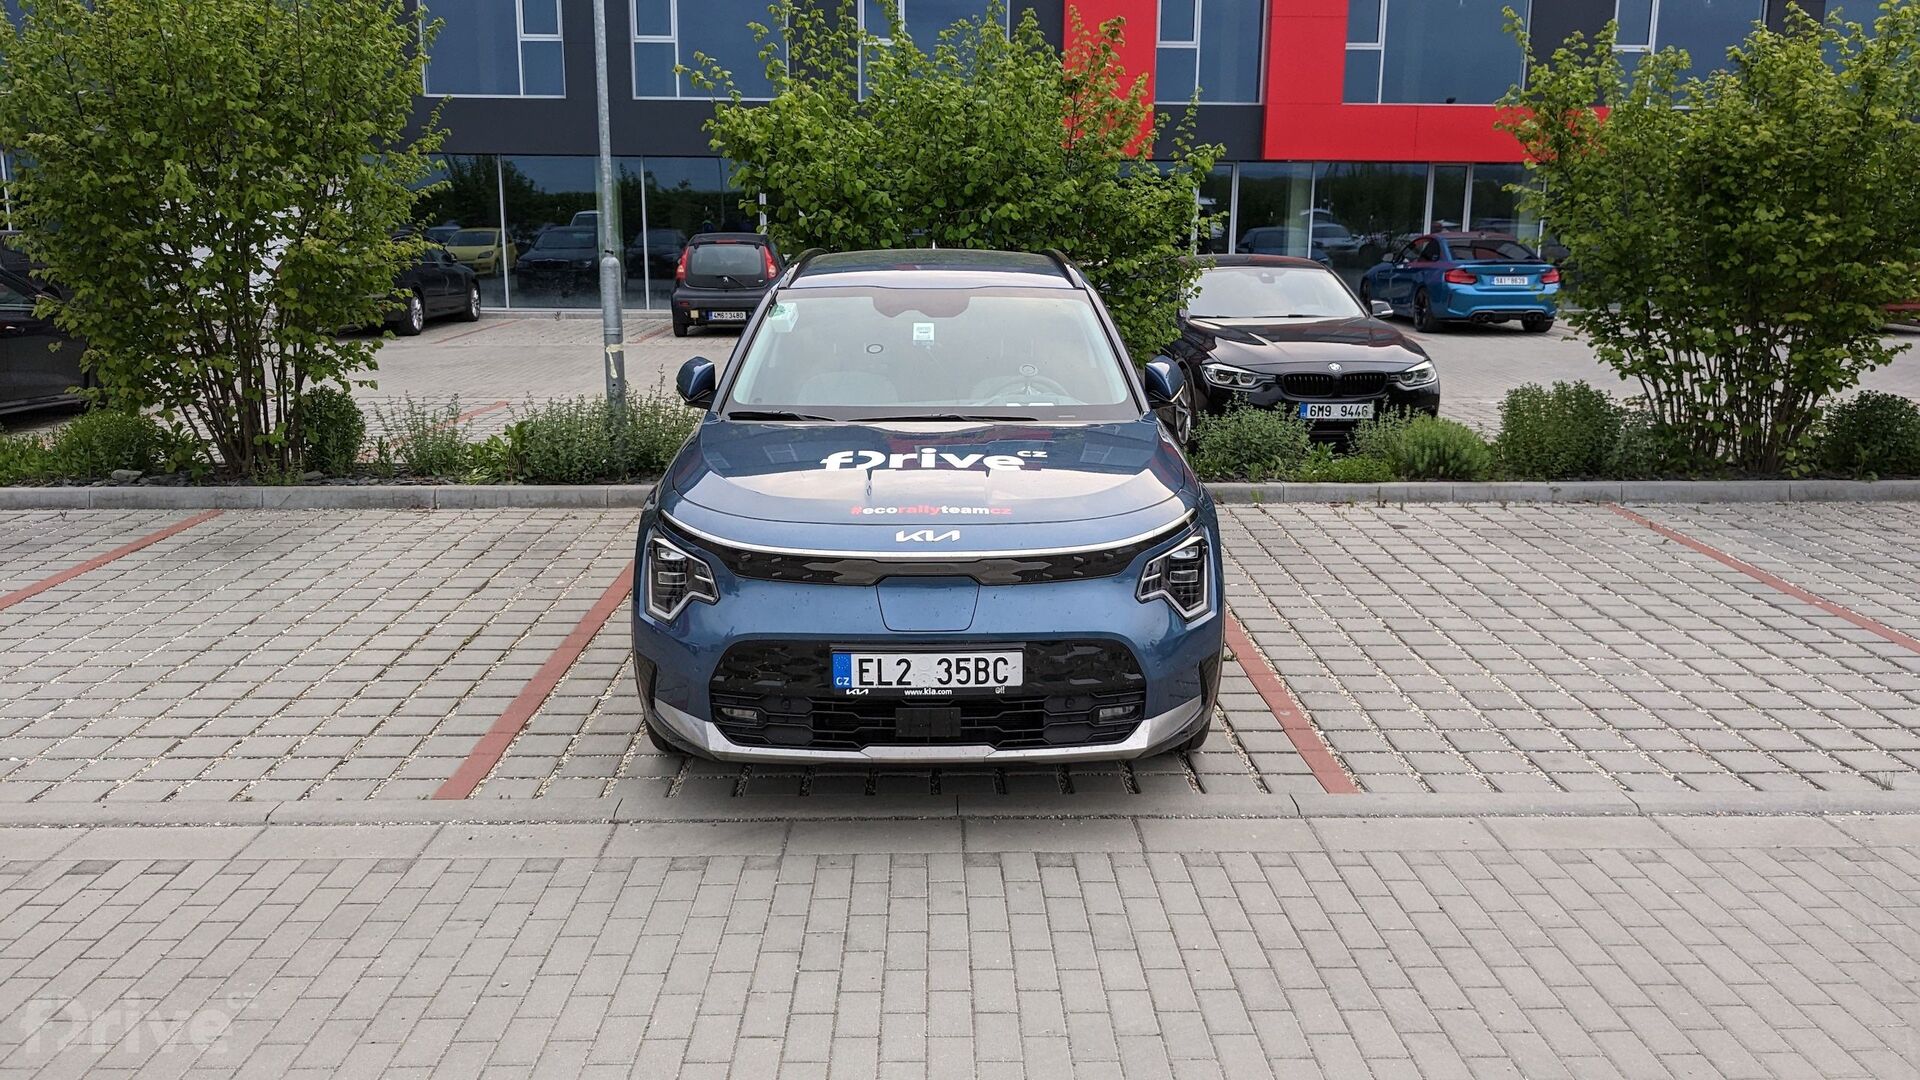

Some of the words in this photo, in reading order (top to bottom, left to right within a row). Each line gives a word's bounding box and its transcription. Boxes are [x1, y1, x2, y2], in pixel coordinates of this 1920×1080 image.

[1309, 405, 1332, 417] 6M9
[1340, 405, 1369, 417] 9446
[851, 505, 1013, 516] #ecorallyteamcz
[896, 529, 961, 542] KIA
[836, 677, 850, 686] CZ
[858, 658, 912, 686] EL2
[936, 657, 1009, 686] 35BC
[904, 687, 953, 696] www.kia.com
